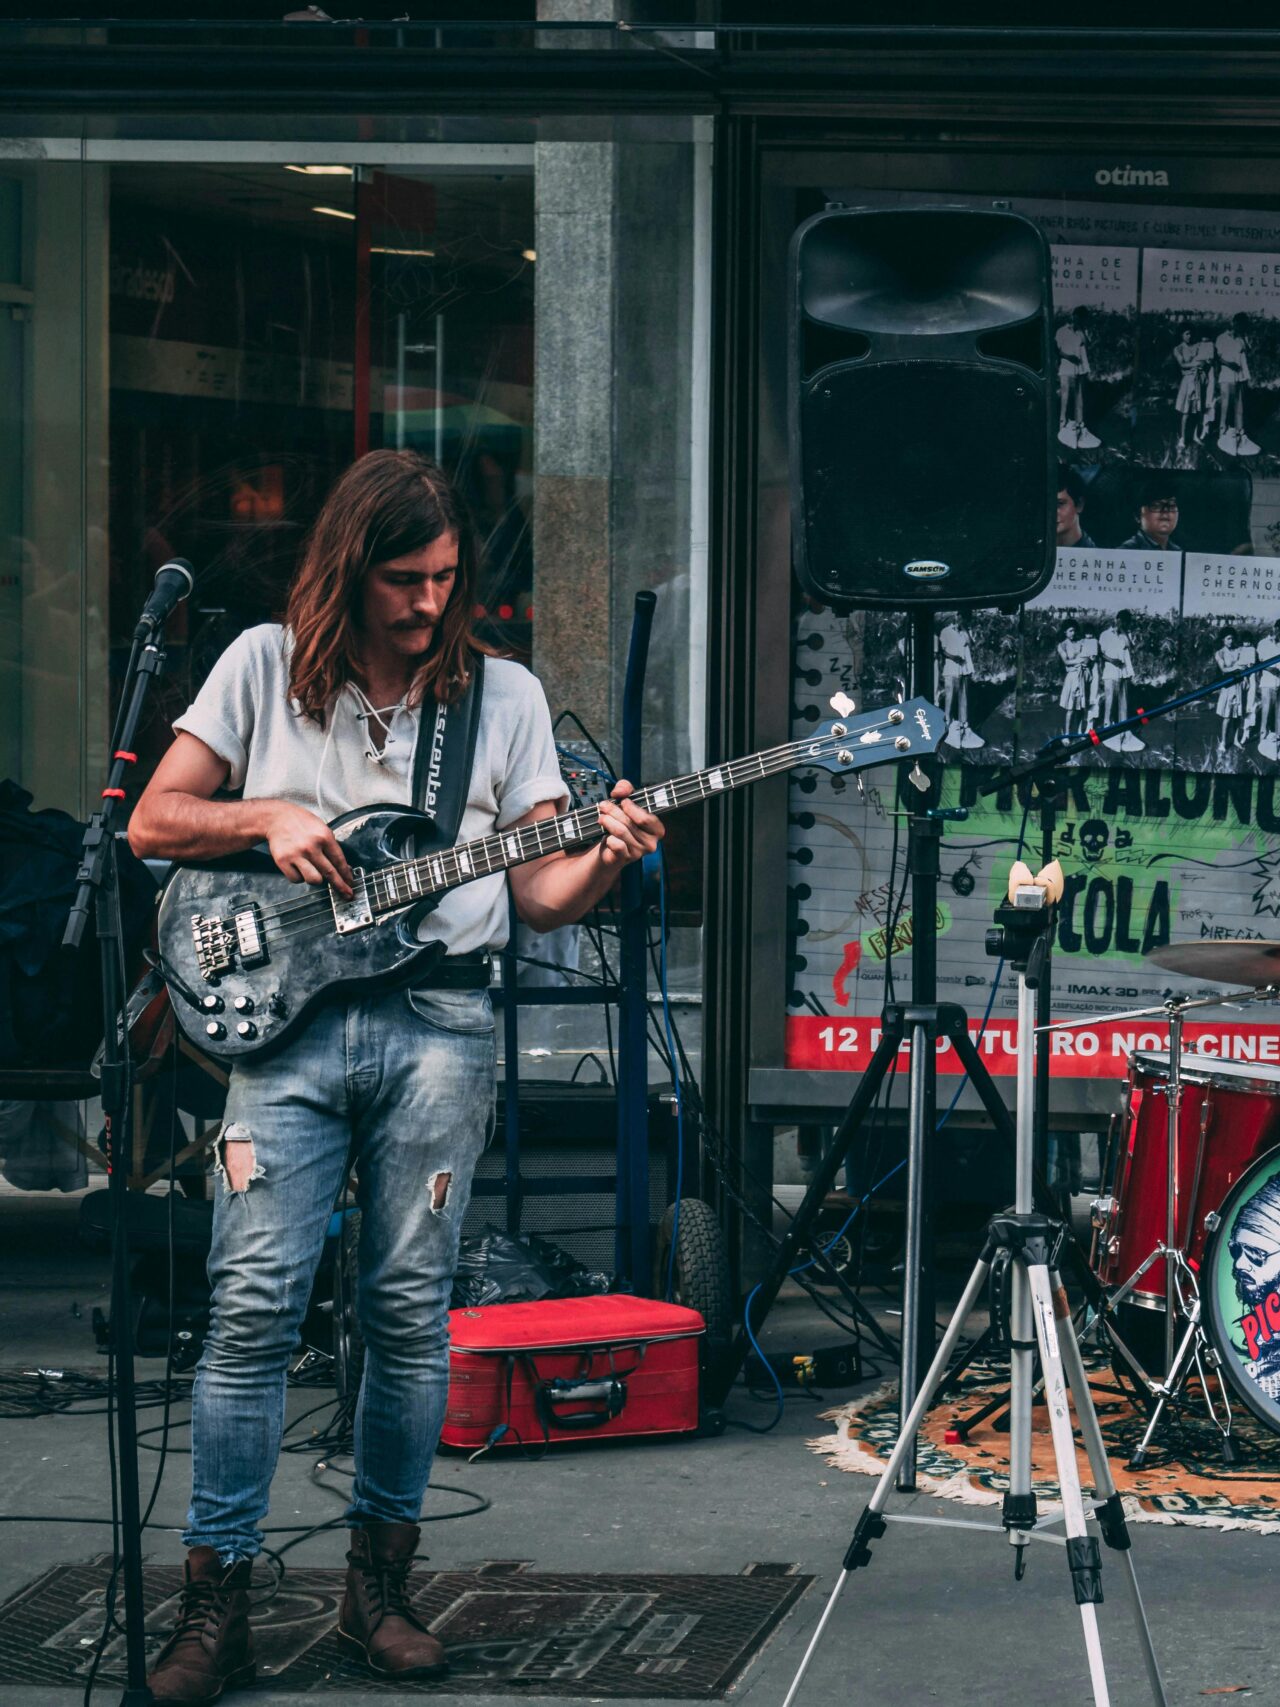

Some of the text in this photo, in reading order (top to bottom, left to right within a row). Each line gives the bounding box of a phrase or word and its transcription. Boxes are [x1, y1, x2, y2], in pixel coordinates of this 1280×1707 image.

[1094, 164, 1170, 187] otima
[1101, 257, 1121, 268] DE
[1161, 260, 1280, 275] PICANHA DE
[1160, 274, 1280, 288] CHERNOBILL
[1144, 560, 1165, 572] DE
[1067, 984, 1138, 998] IMAX 3D
[818, 1027, 857, 1052] 12
